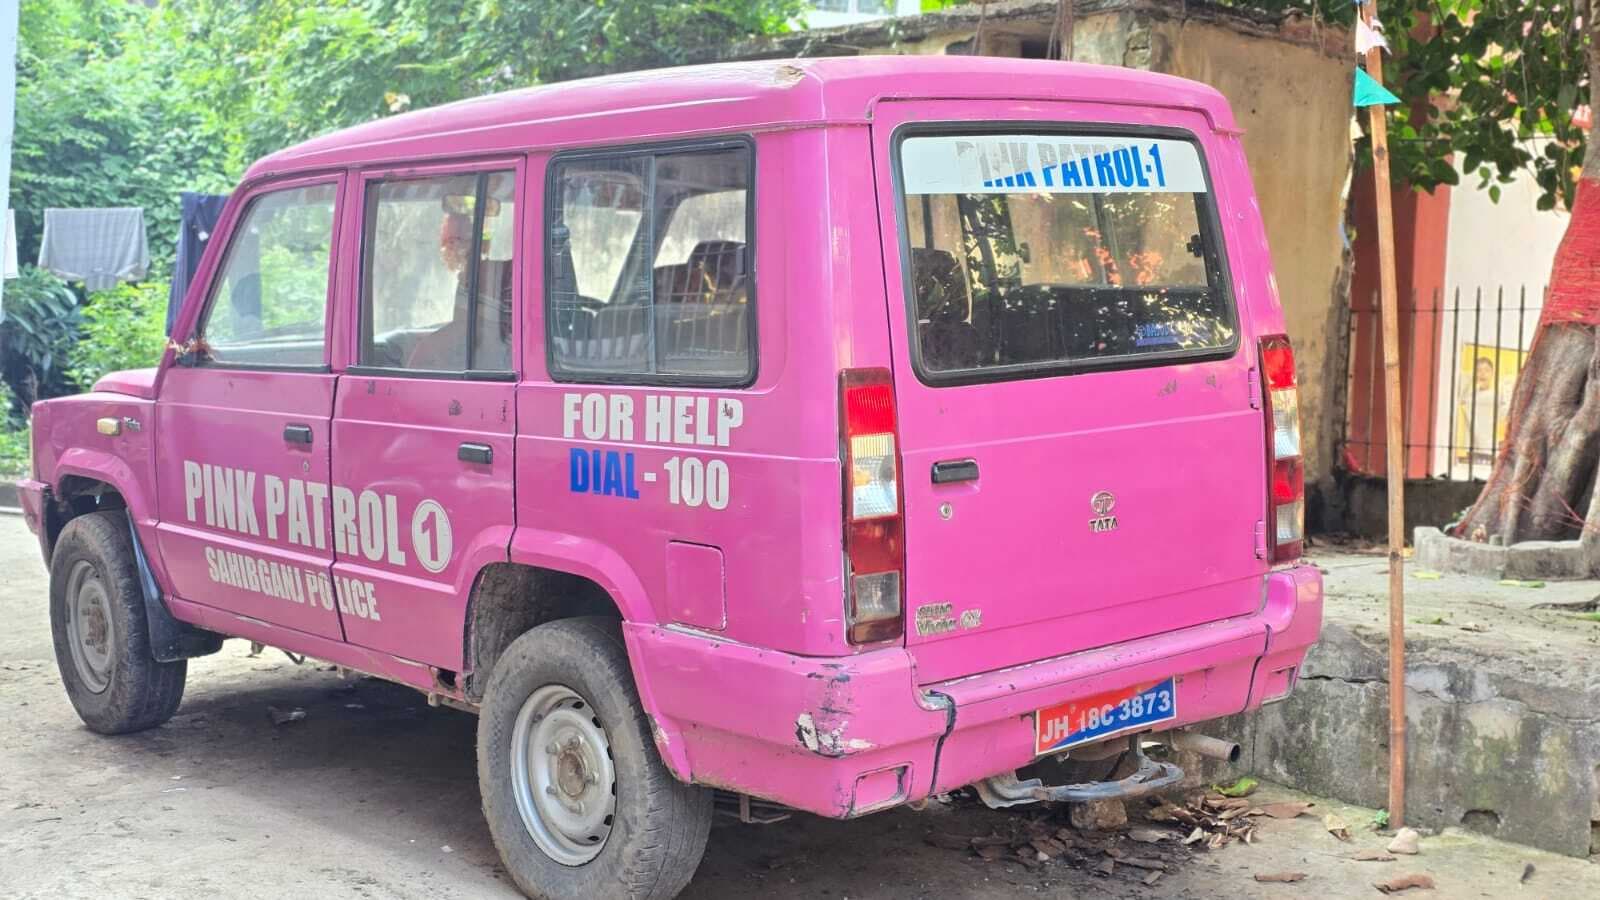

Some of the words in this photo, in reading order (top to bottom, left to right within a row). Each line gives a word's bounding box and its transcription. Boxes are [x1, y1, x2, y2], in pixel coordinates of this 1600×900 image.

[1036, 143, 1166, 187] PATROL-1
[563, 393, 634, 440] FOR
[644, 395, 744, 446] HELP
[569, 448, 640, 499] DIAL
[664, 456, 730, 510] 100
[184, 460, 260, 536] PINK
[264, 474, 406, 566] PATROL
[1088, 517, 1118, 532] TATA
[205, 546, 305, 604] SAHIBGANJ
[305, 570, 381, 621] POLICE
[1041, 715, 1070, 743] JH
[1078, 703, 1115, 733] 18C
[1118, 690, 1171, 722] 3873
